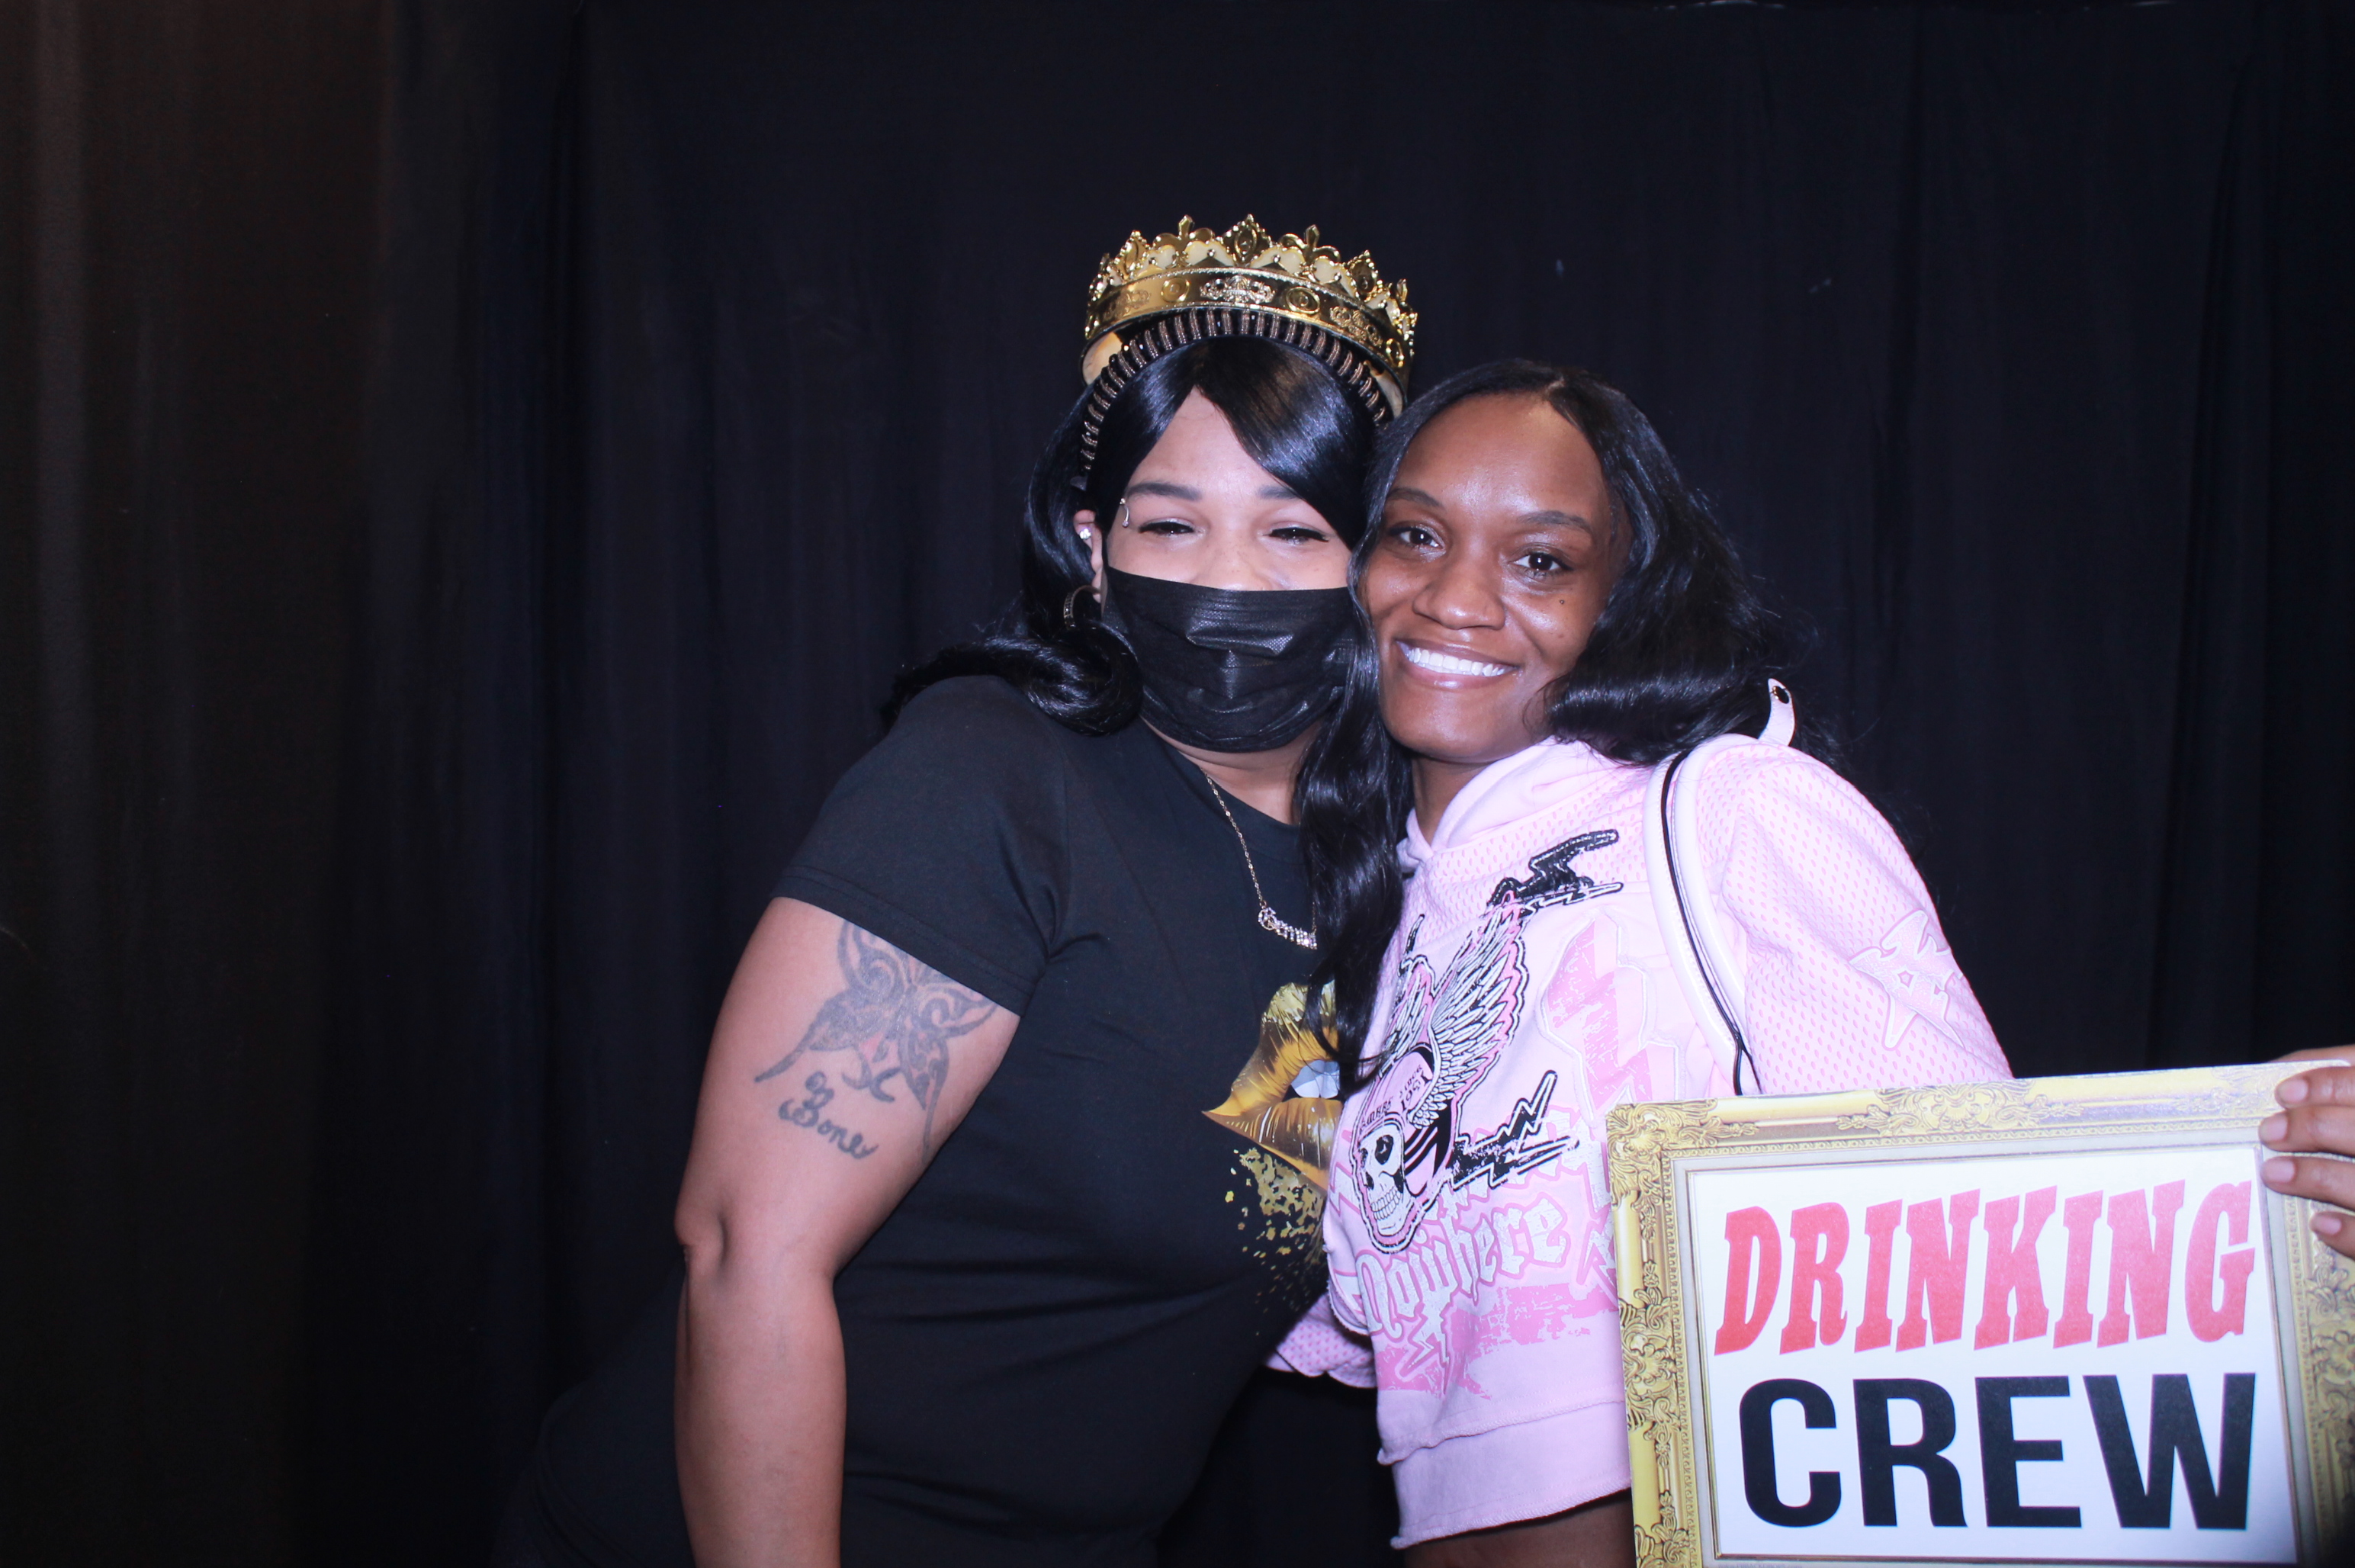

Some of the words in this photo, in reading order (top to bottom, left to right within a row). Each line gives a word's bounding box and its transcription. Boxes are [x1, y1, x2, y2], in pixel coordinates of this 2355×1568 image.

[778, 1071, 879, 1159] Bone
[1714, 1179, 2255, 1356] DRINKING
[1739, 1373, 2256, 1530] CREW
